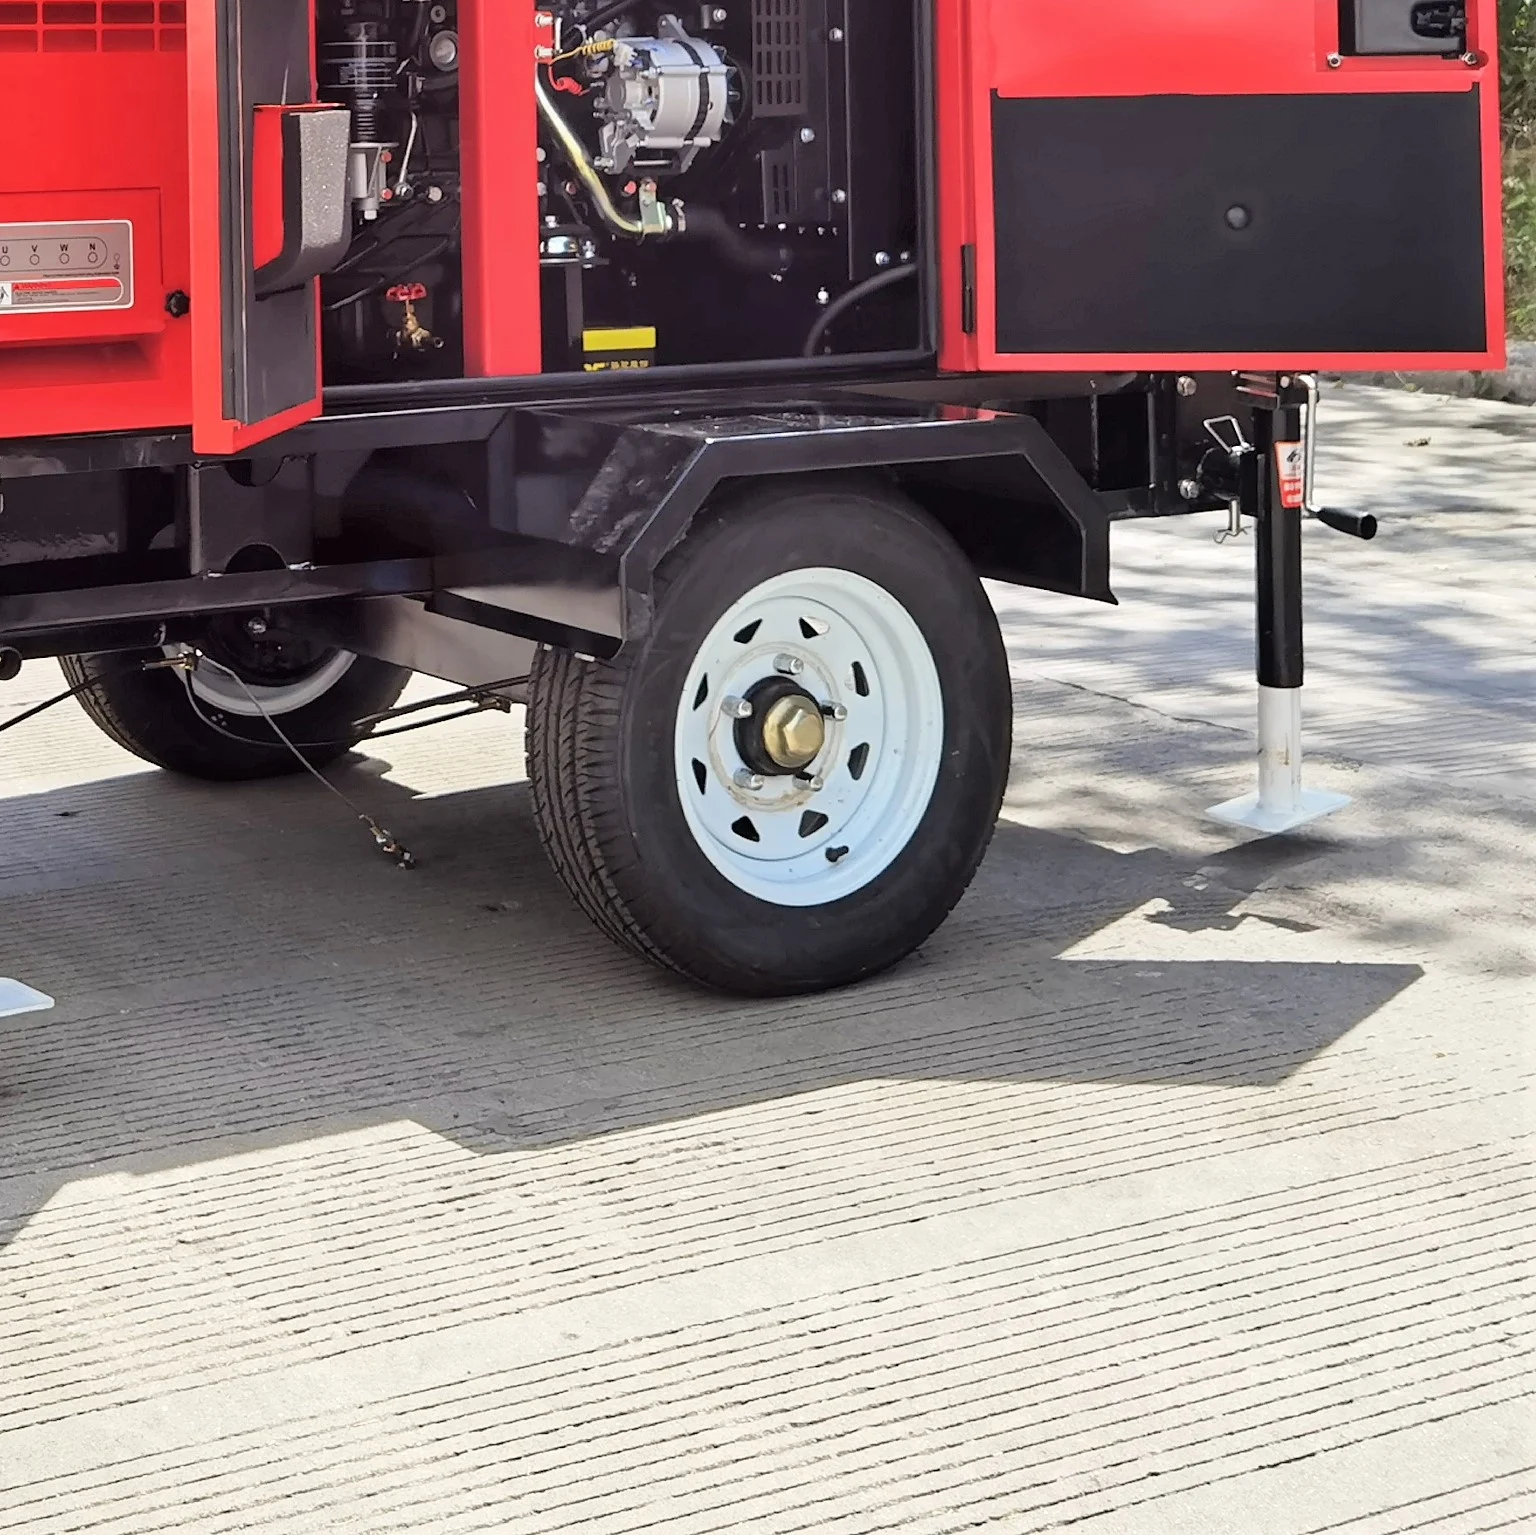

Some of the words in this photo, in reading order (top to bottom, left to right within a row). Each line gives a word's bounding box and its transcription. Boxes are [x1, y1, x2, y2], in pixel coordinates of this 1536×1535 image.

[1, 246, 9, 254] U
[59, 244, 68, 252] W
[89, 243, 96, 251] N
